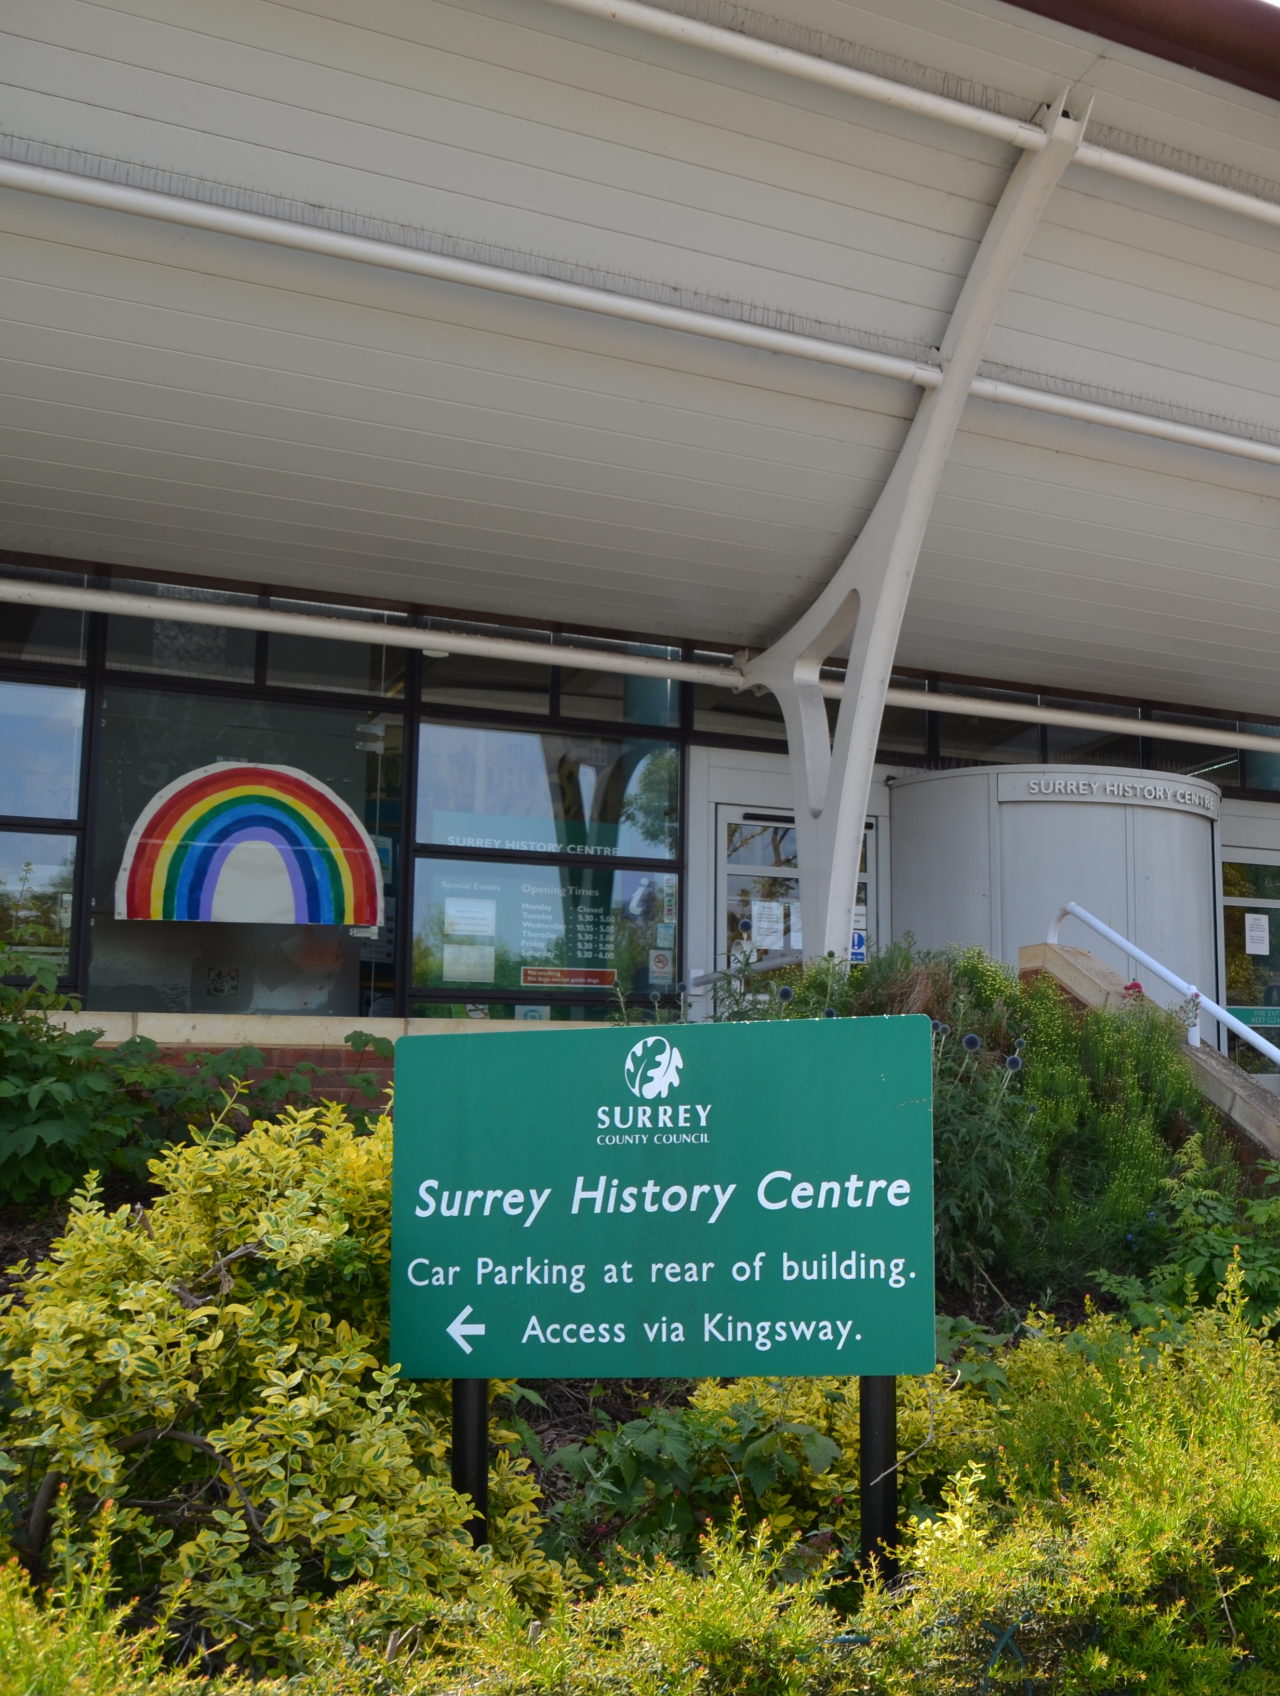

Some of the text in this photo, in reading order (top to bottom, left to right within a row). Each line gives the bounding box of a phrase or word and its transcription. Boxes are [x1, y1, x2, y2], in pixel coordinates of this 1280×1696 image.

[1028, 780, 1215, 809] SURREY HISTORY CENTRE
[447, 836, 621, 857] SURREY HISTORY CENTRE
[521, 884, 600, 896] Opening Times
[597, 1105, 712, 1129] SURREY
[596, 1132, 711, 1145] COUNTY COUNCIL
[415, 1171, 911, 1227] Surrey History Centre
[407, 1251, 917, 1293] Car Parking at rear of building.
[521, 1313, 862, 1351] Access via Kingsway.
